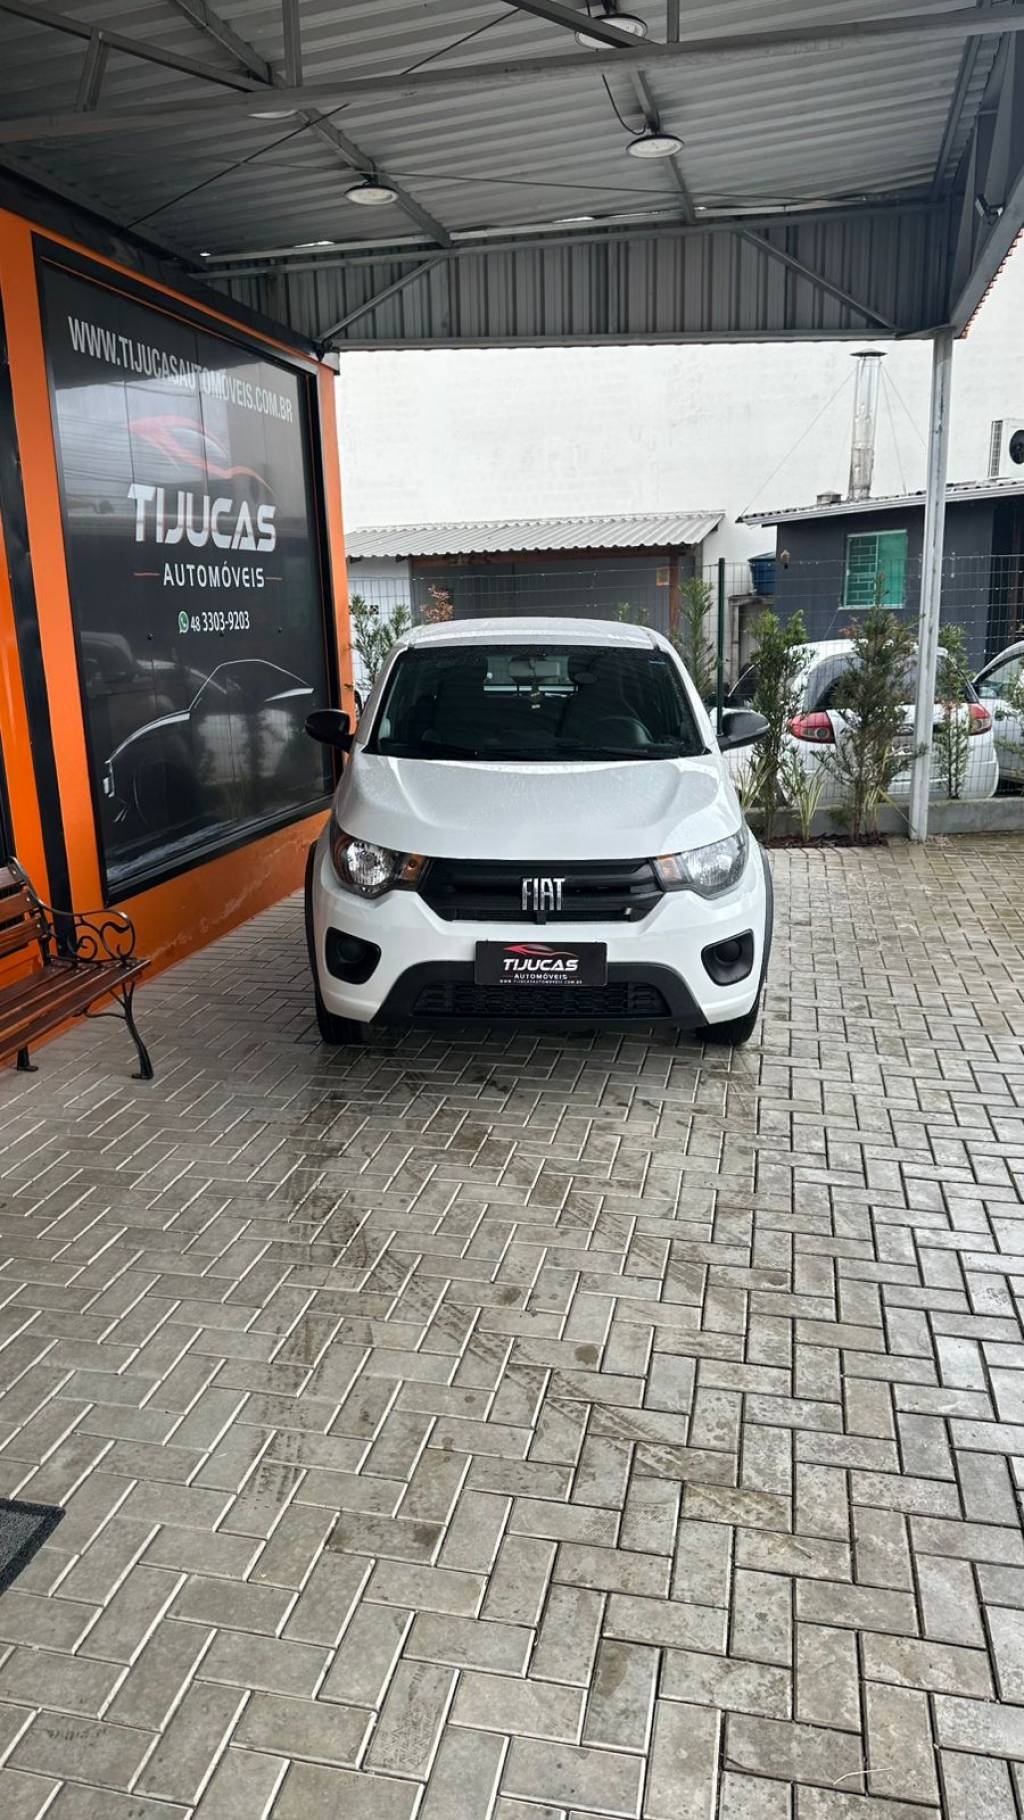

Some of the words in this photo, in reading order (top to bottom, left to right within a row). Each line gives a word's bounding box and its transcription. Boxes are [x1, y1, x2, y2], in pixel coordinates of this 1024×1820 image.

[128, 483, 276, 552] TIJUCAS
[163, 561, 265, 588] AUTOMÓVEIS
[190, 616, 201, 631] 48
[202, 611, 250, 631] 3303-9203
[522, 878, 566, 911] FIAT
[503, 959, 580, 971] TIJUCAS
